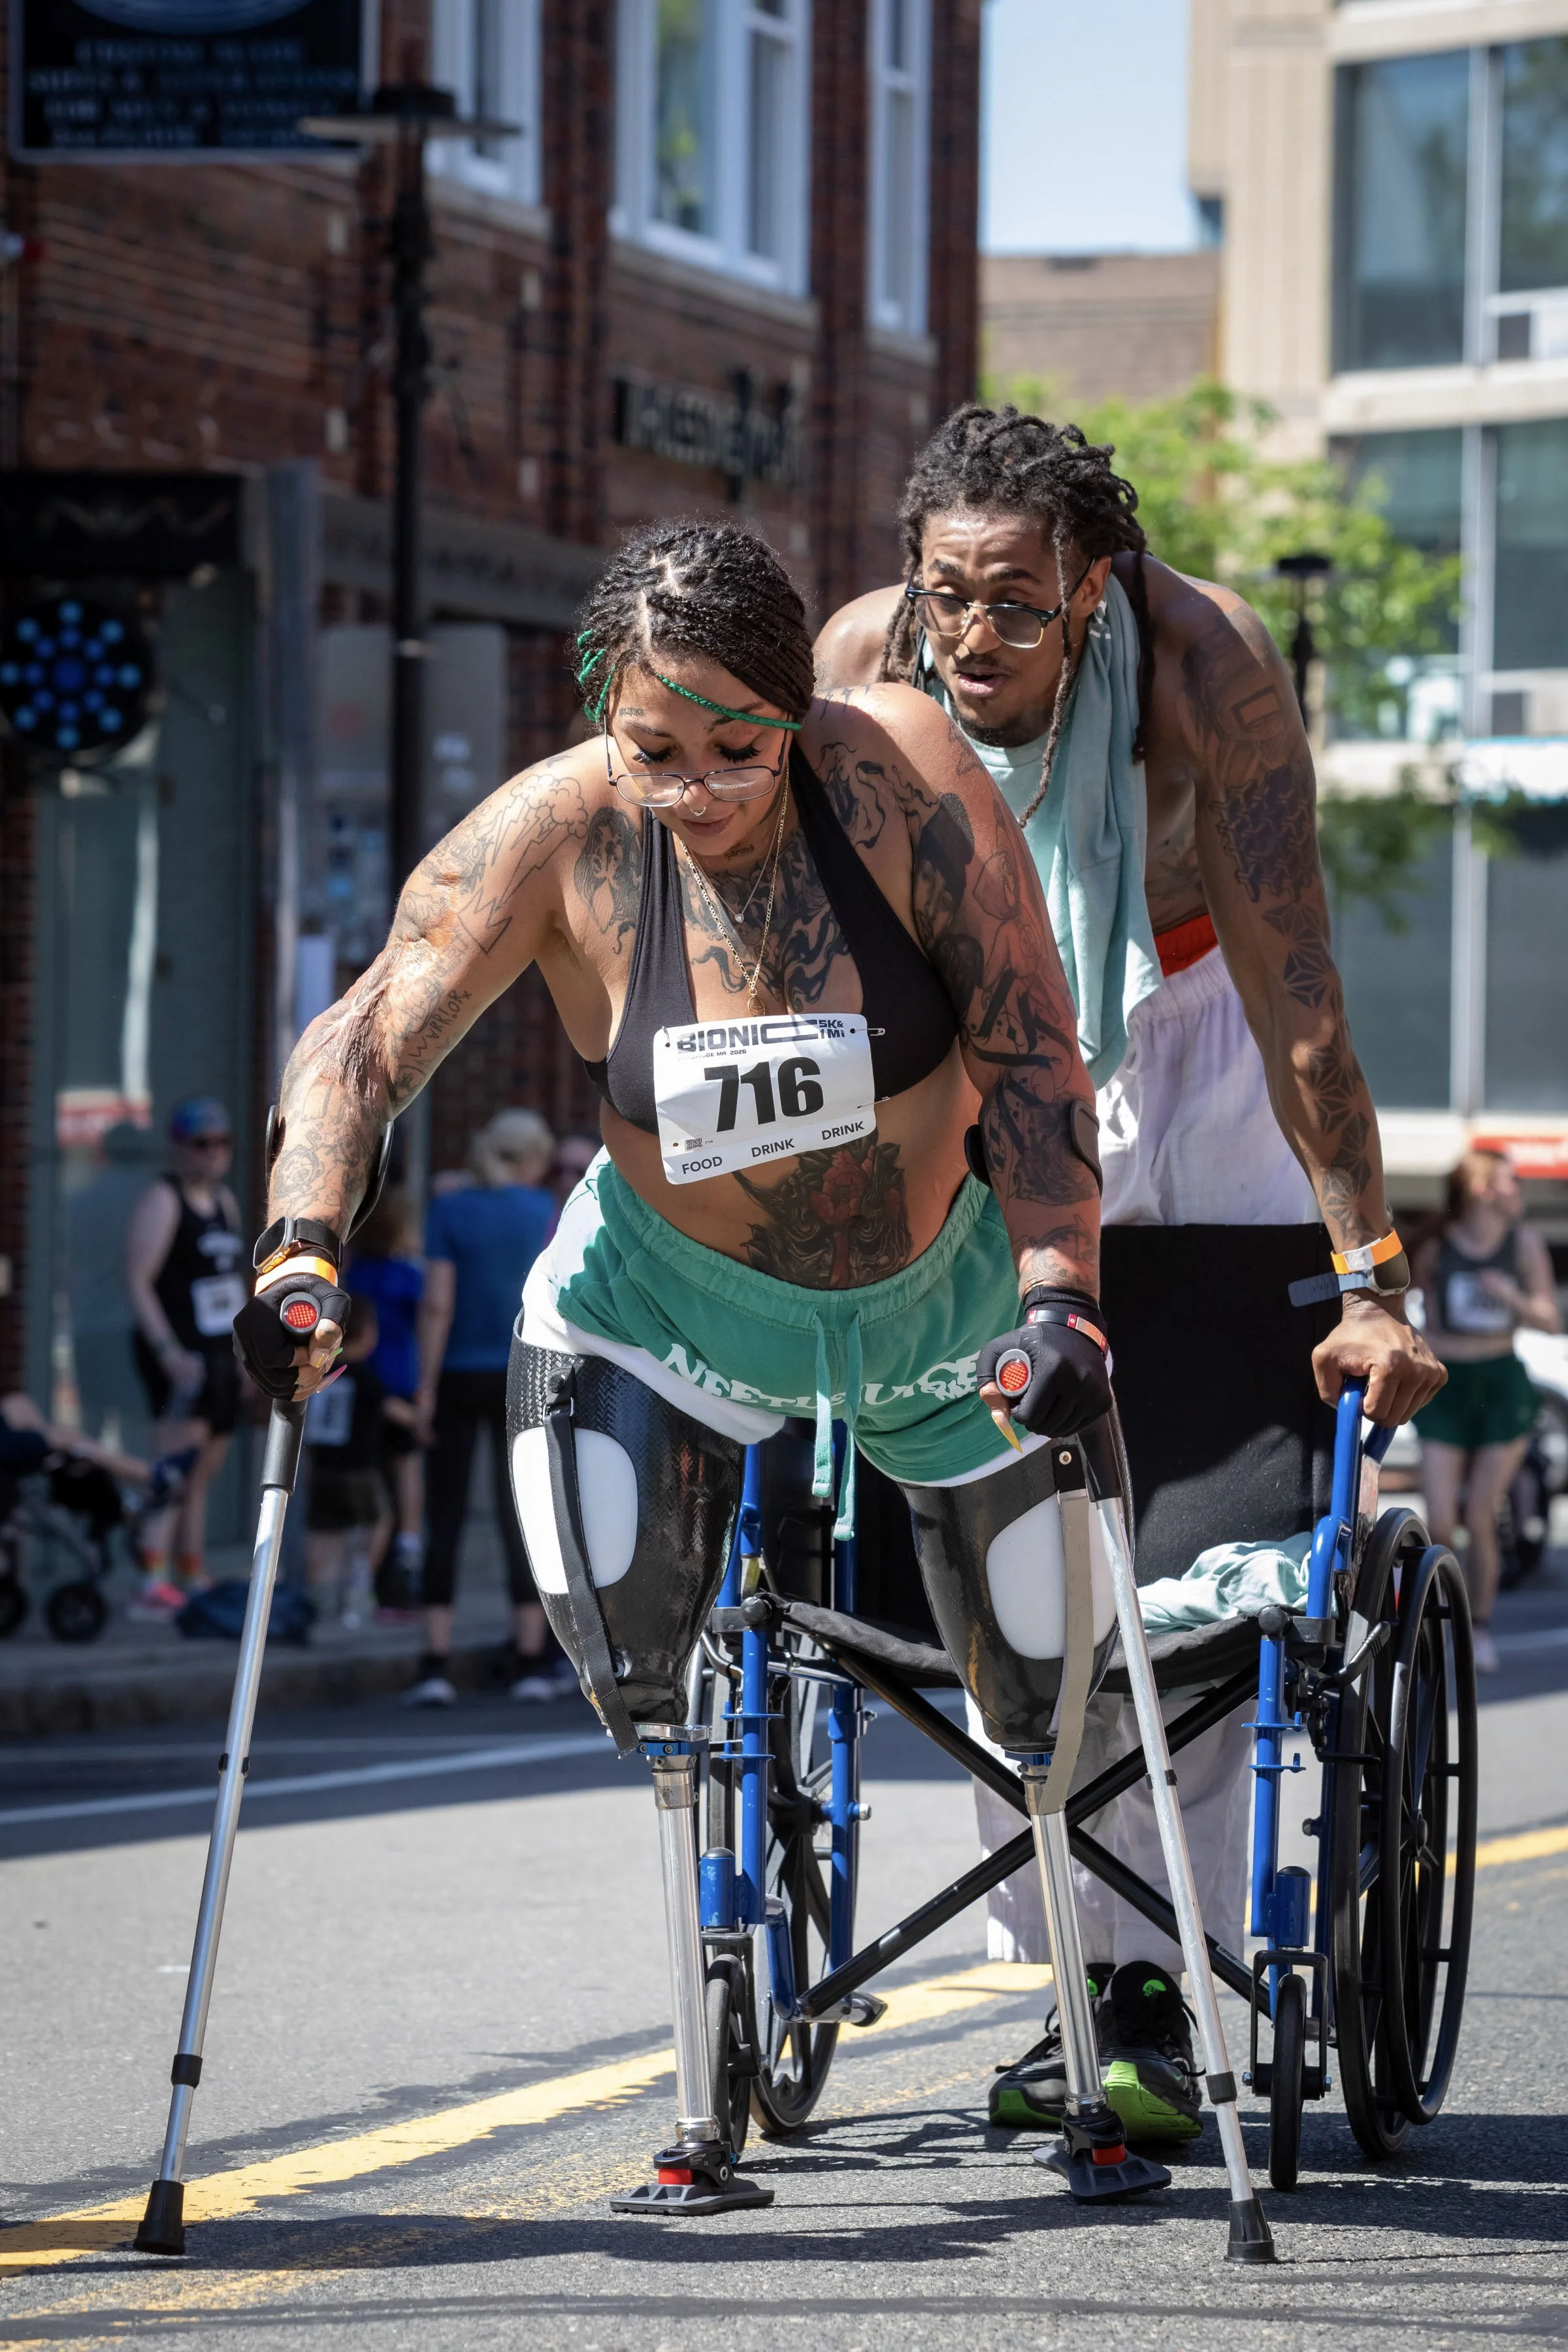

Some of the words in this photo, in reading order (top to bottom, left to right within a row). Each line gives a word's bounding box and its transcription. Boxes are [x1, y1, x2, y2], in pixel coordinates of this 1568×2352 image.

[677, 1019, 819, 1054] BIONIC
[819, 1020, 843, 1028] 5K&
[704, 1056, 825, 1133] 716
[681, 1156, 723, 1175] FOOD
[751, 1138, 795, 1158] DRINK
[821, 1120, 864, 1141] DRINK
